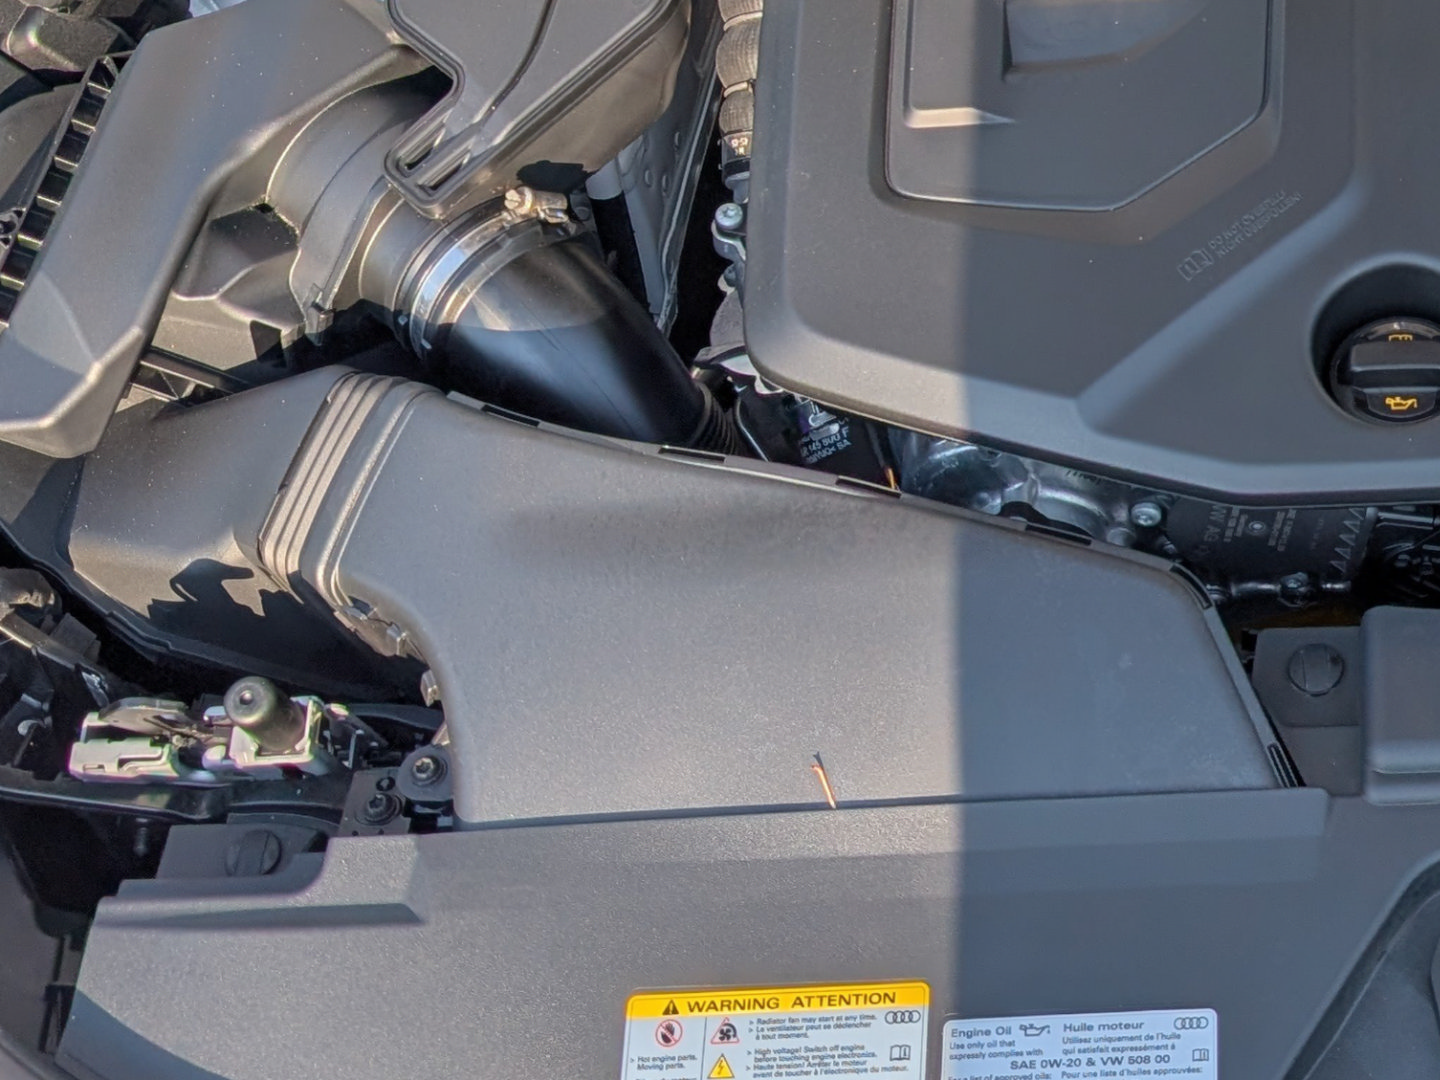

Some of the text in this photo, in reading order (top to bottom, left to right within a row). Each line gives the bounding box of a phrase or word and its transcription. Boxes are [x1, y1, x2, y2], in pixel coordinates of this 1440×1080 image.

[687, 992, 896, 1013] WARNING ATTENTION
[1063, 1021, 1145, 1032] Huile moteur
[951, 1026, 1012, 1039] Engine Oil
[1093, 1035, 1142, 1043] uniquement
[1144, 1033, 1154, 1041] de
[804, 1045, 827, 1053] Switch
[840, 1044, 865, 1052] engine
[949, 1039, 1016, 1050] Use only oil that
[949, 1048, 1043, 1060] expressly complies with
[1062, 1047, 1076, 1056] qui
[1077, 1045, 1109, 1054] satisfait
[811, 1053, 836, 1061] engine
[1010, 1054, 1171, 1070] SAE 0W-20 & VW 508 00
[637, 1063, 664, 1071] Moving
[1061, 1071, 1080, 1079] Pour
[1100, 1069, 1117, 1077] liste
